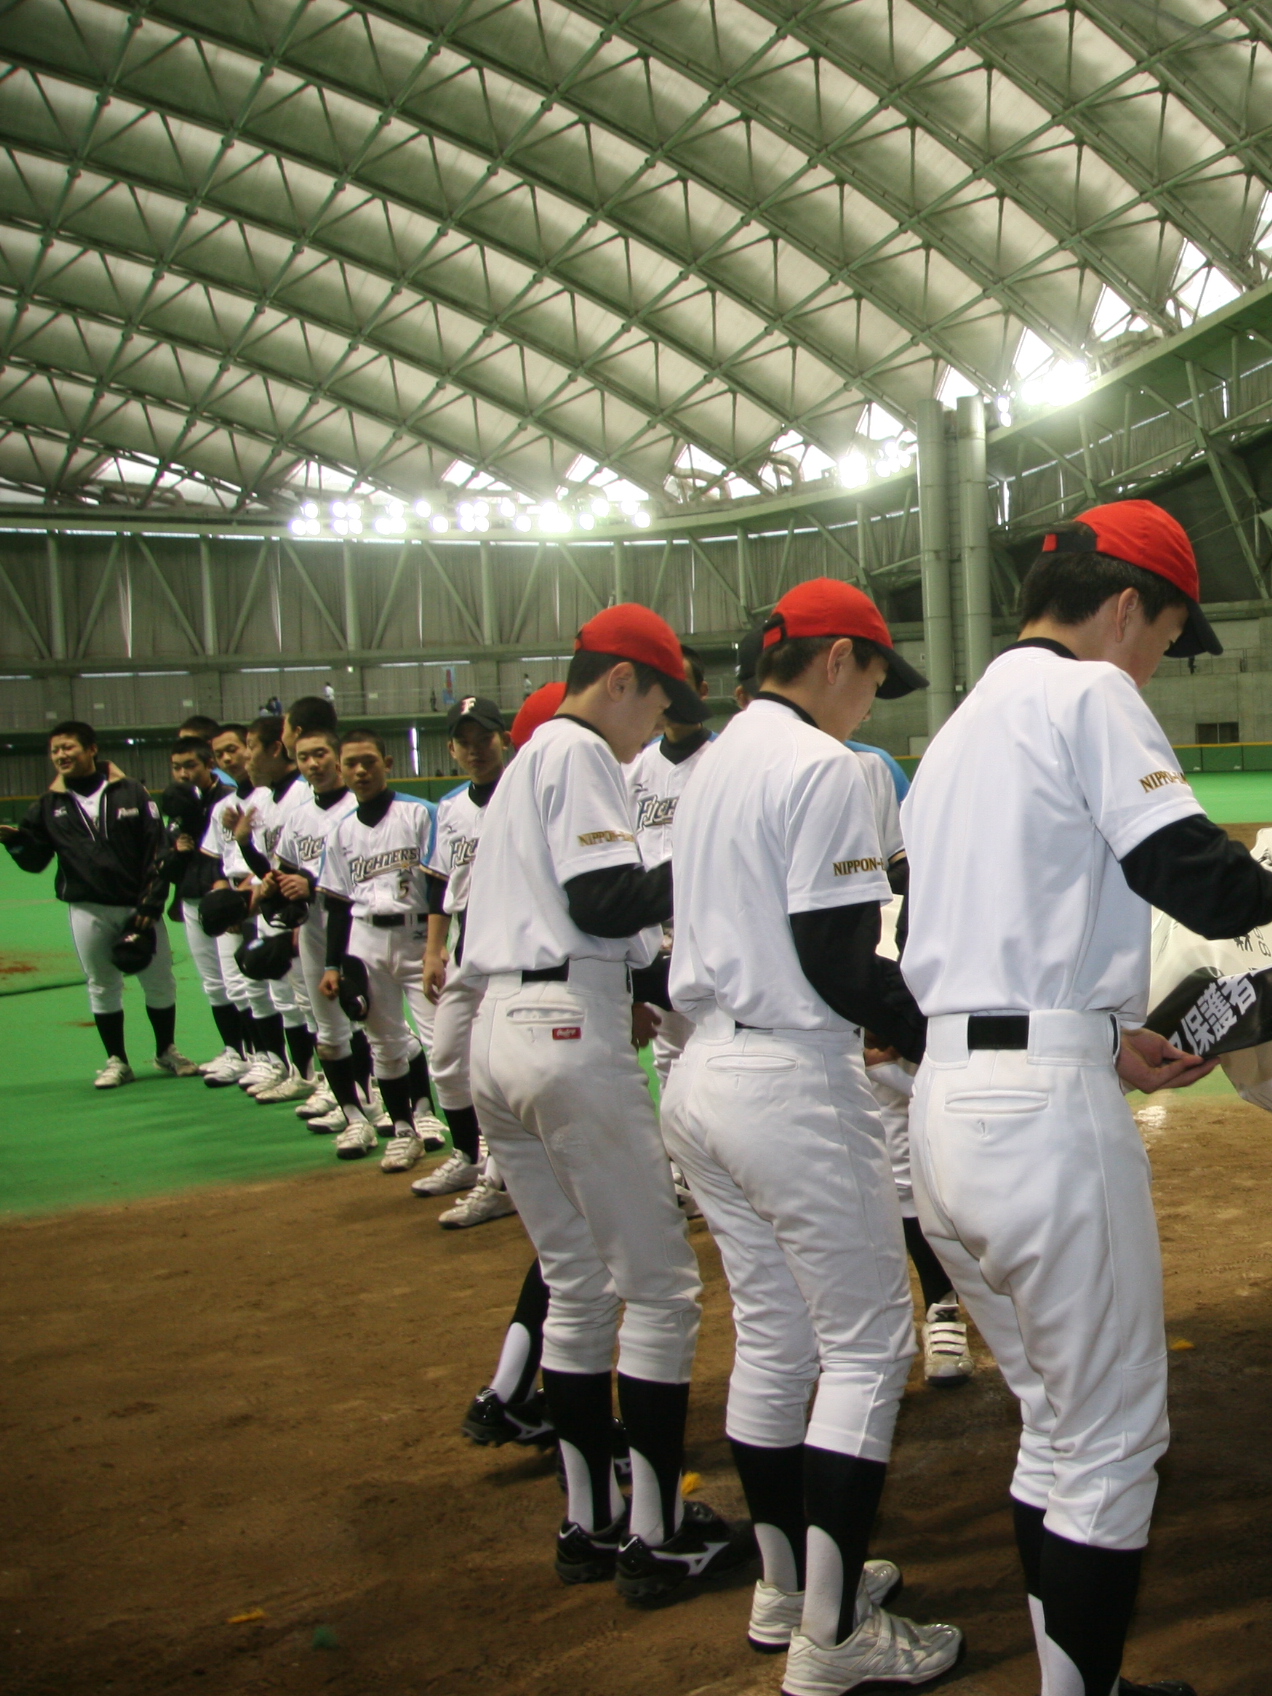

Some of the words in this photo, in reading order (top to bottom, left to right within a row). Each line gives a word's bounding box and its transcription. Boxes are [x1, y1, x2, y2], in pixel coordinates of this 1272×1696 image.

[461, 697, 477, 715] F
[349, 848, 420, 886] FIGHTERS
[398, 880, 410, 899] 5
